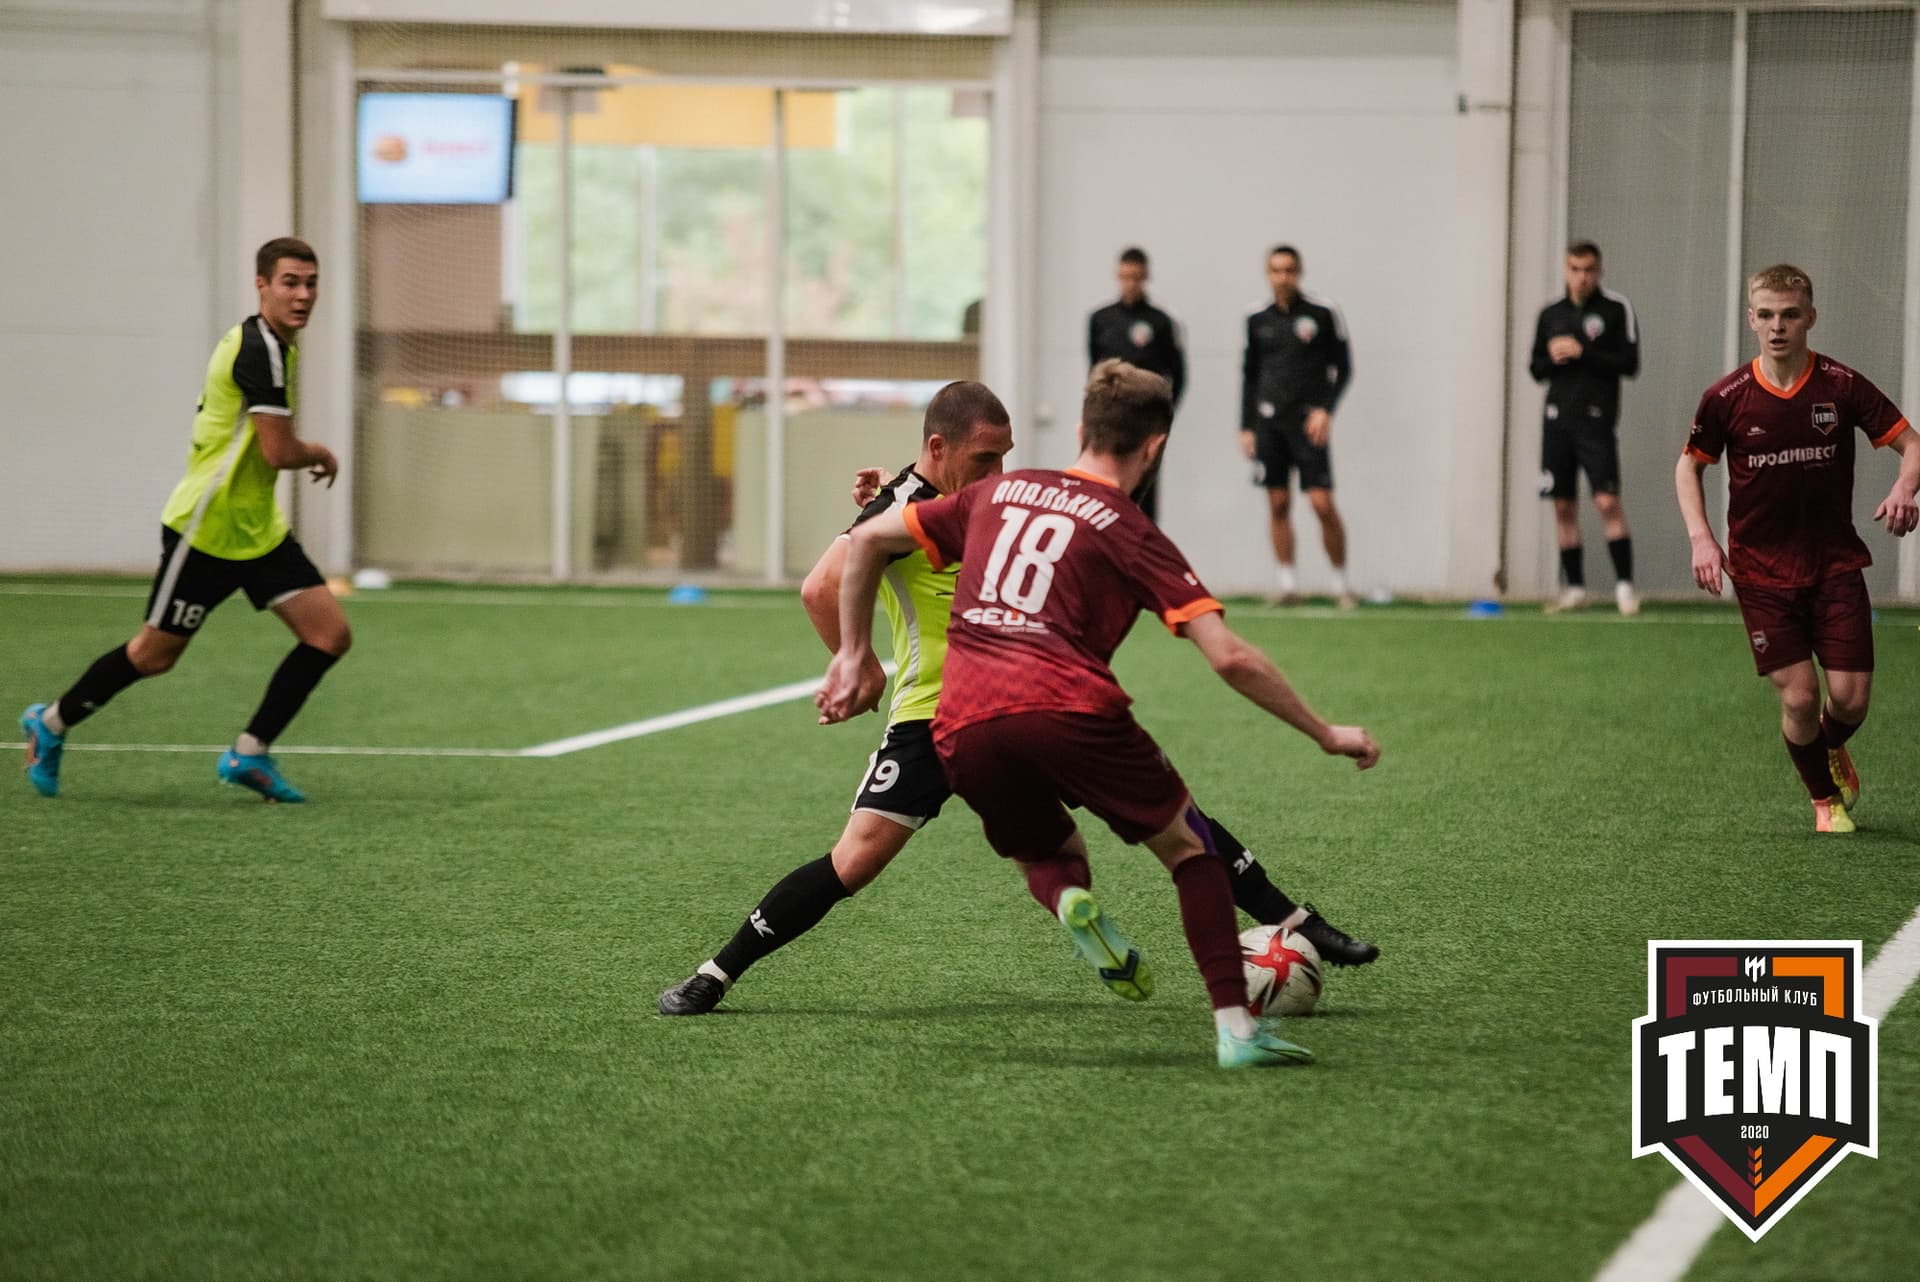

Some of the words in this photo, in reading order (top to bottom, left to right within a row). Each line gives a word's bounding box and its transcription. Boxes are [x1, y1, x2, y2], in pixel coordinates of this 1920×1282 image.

[991, 479, 1120, 531] АПАЛЬКИН
[978, 505, 1076, 615] 18
[171, 598, 206, 629] 18
[869, 759, 900, 793] 9
